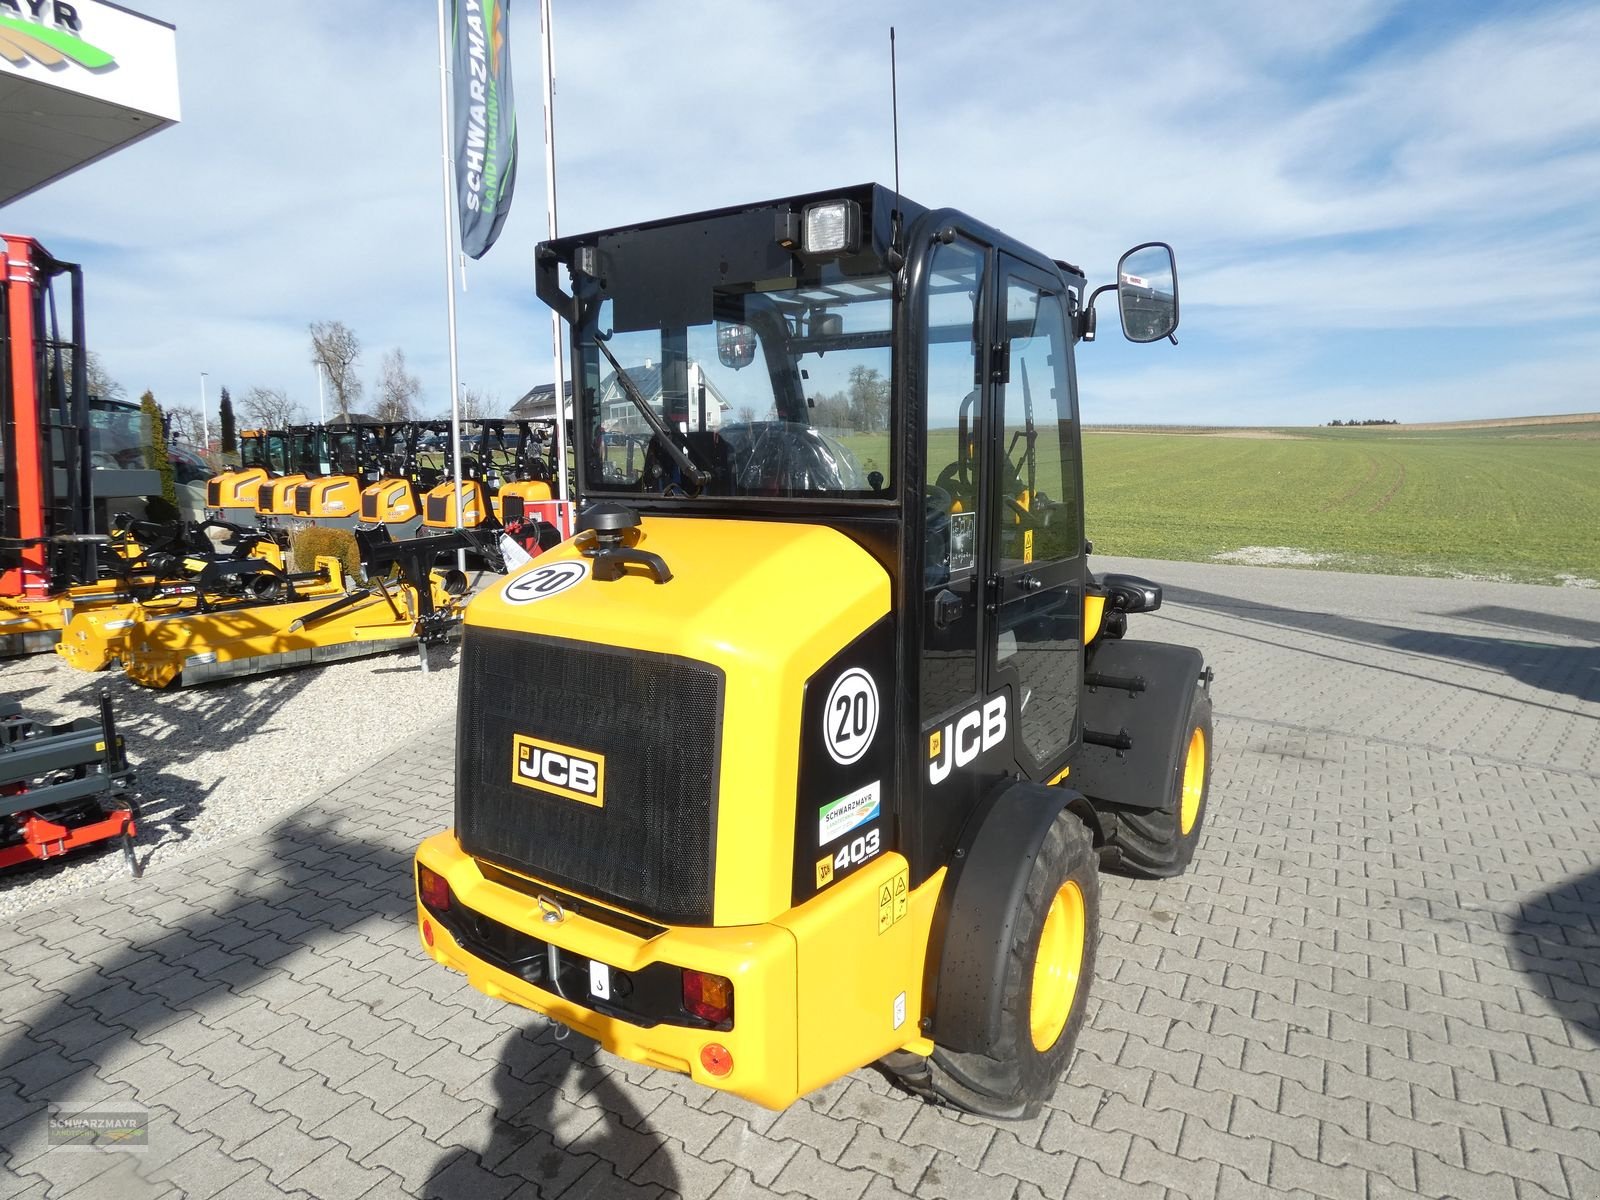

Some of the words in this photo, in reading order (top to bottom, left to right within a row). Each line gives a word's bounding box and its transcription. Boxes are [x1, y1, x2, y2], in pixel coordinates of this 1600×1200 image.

[513, 569, 575, 592] 20
[835, 690, 868, 744] 20
[929, 695, 1007, 786] JCB
[520, 748, 596, 794] JCB
[825, 793, 873, 823] SCHWARZMAYR
[834, 828, 880, 870] 403
